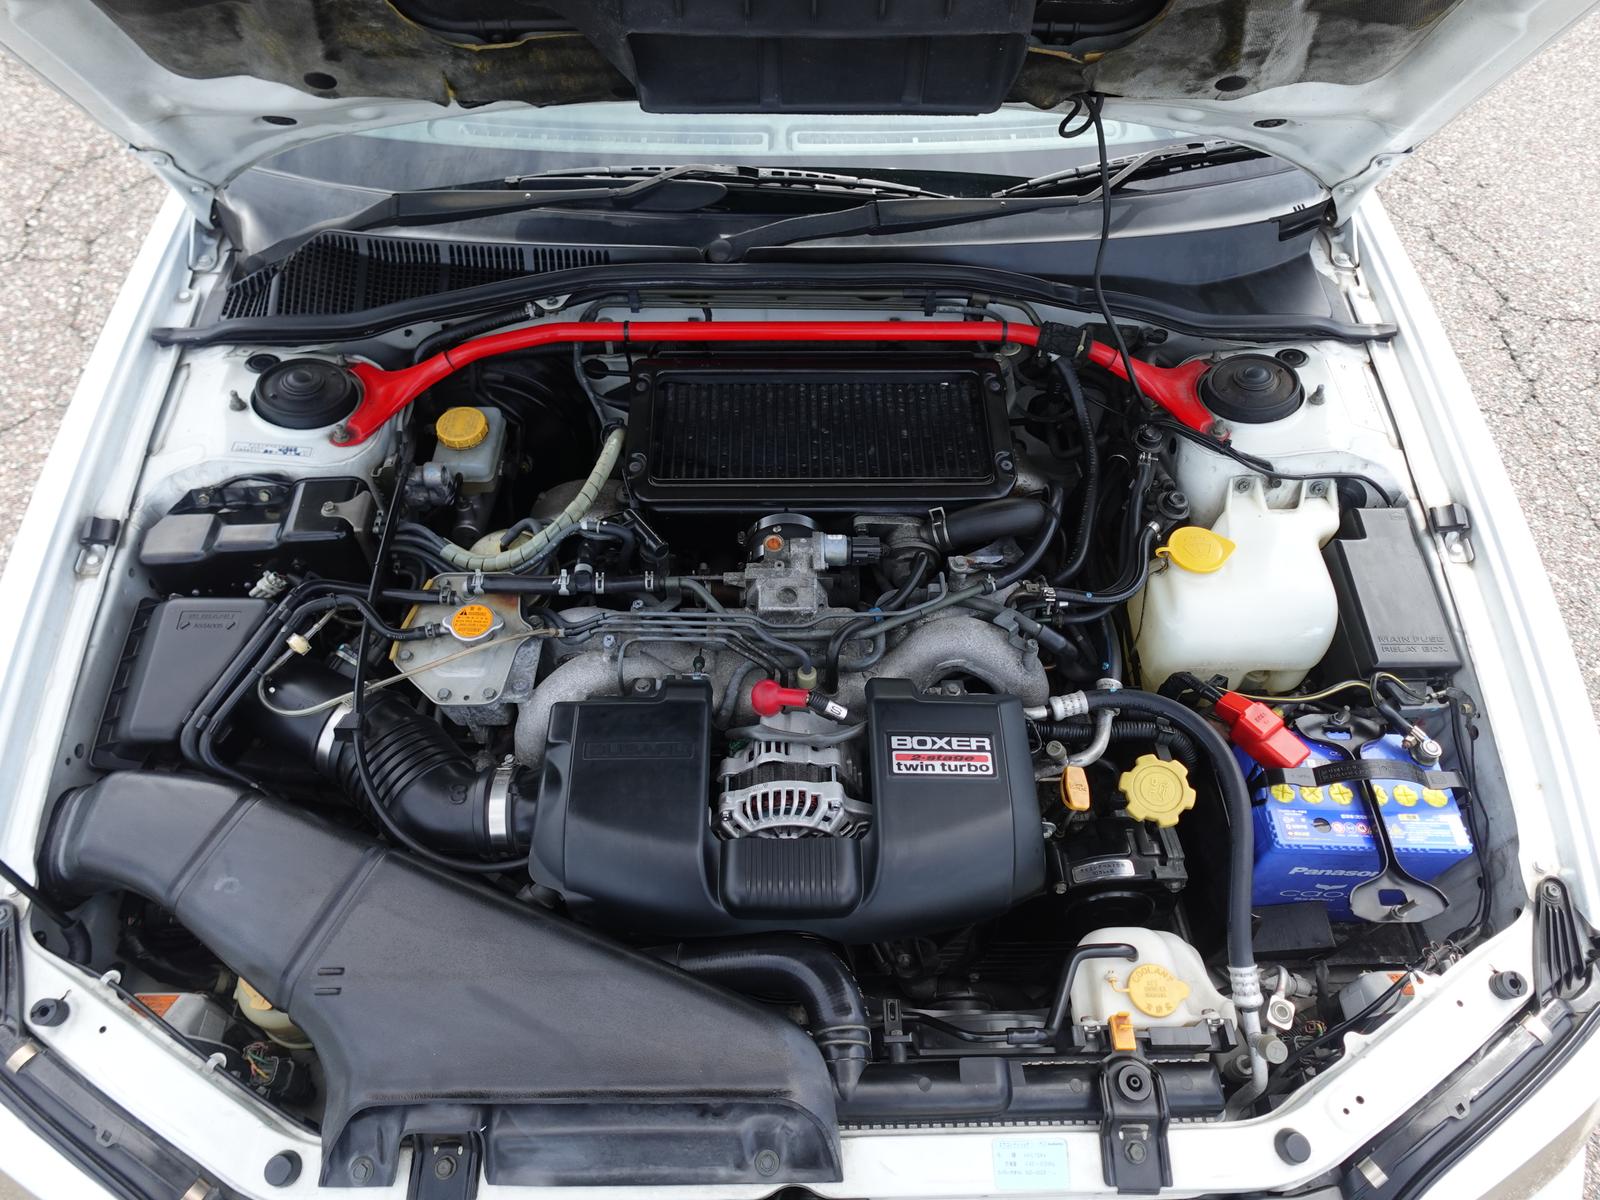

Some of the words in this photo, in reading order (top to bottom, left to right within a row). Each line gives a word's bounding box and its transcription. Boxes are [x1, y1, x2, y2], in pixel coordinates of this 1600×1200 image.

[830, 705, 842, 716] S
[891, 735, 992, 751] BOXER
[910, 753, 975, 762] 2-stage
[896, 761, 936, 772] twin
[940, 762, 990, 773] turbo
[1279, 889, 1349, 899] cao
